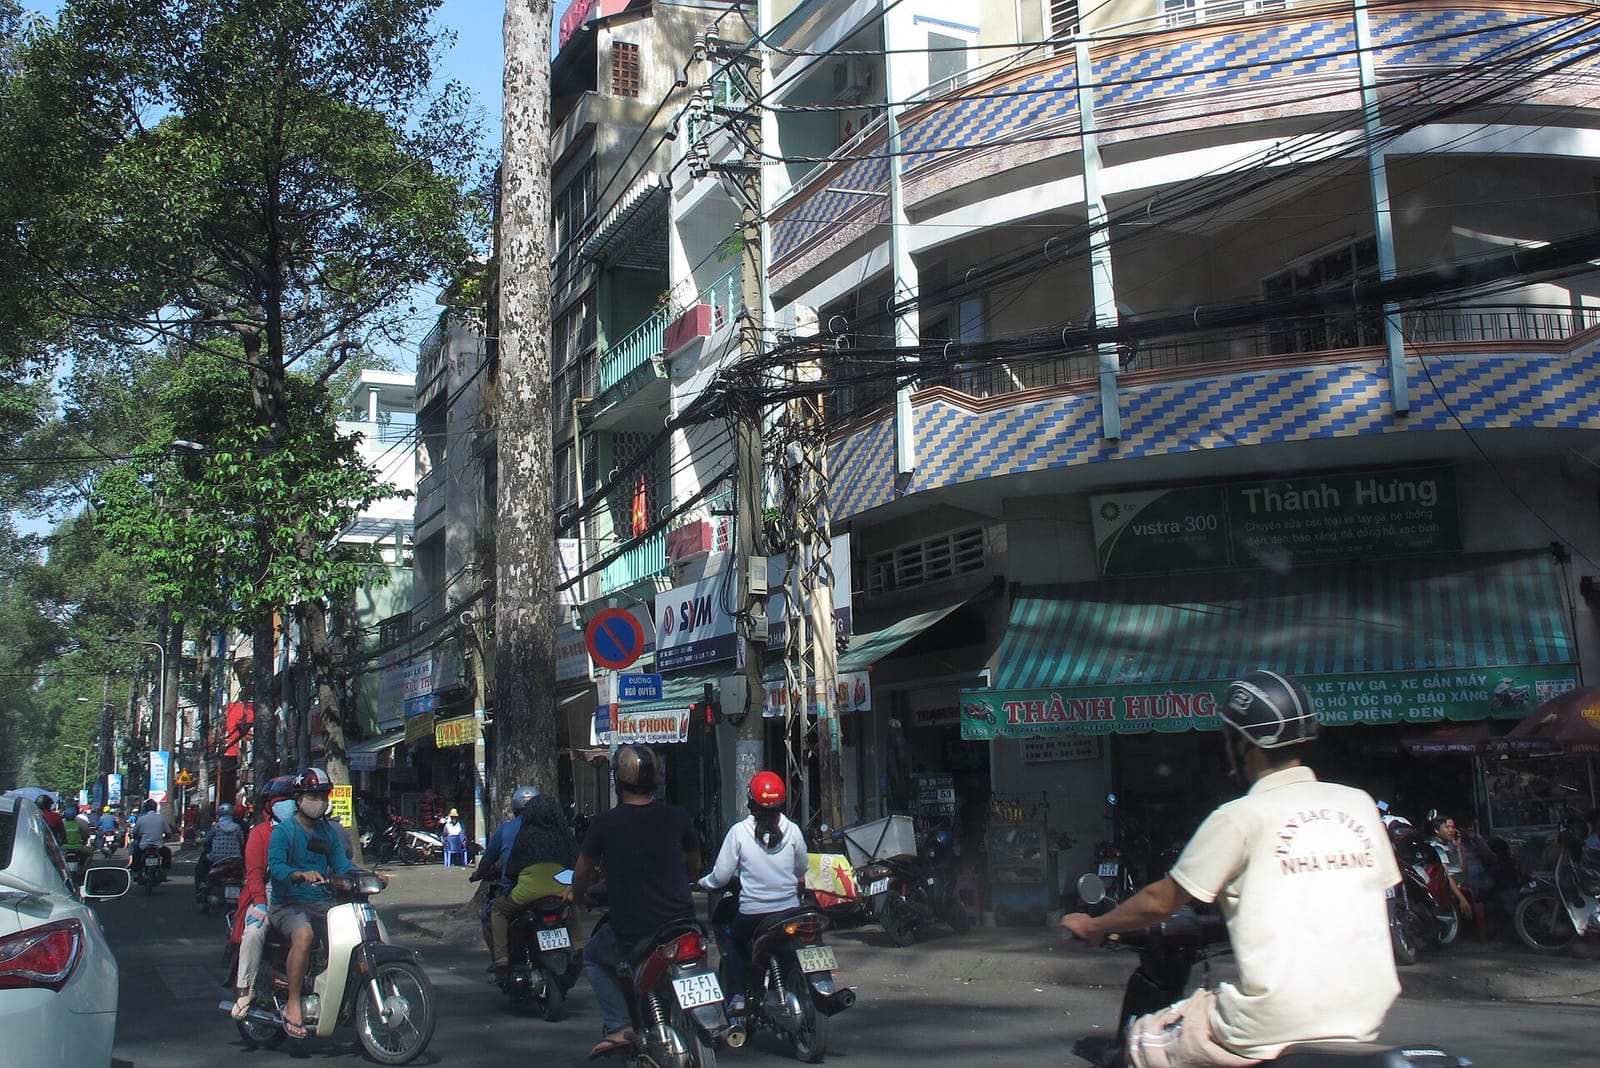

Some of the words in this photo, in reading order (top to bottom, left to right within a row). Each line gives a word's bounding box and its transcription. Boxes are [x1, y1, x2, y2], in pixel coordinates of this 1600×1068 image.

[1241, 483, 1340, 513] Thành
[1355, 479, 1439, 507] Hưng
[1132, 520, 1180, 535] vistra
[1183, 513, 1217, 532] 300
[680, 595, 712, 633] SYM
[1315, 682, 1335, 694] XE
[1337, 681, 1365, 692] TAY
[1368, 680, 1388, 691] GA
[1400, 679, 1419, 689] XE
[1455, 673, 1488, 688] MÁY
[1003, 693, 1115, 724] THÀNH
[1122, 690, 1216, 721] HƯNG
[639, 717, 677, 732] PHONG
[679, 976, 712, 993] 72-F1
[680, 988, 722, 1007] 252.76
